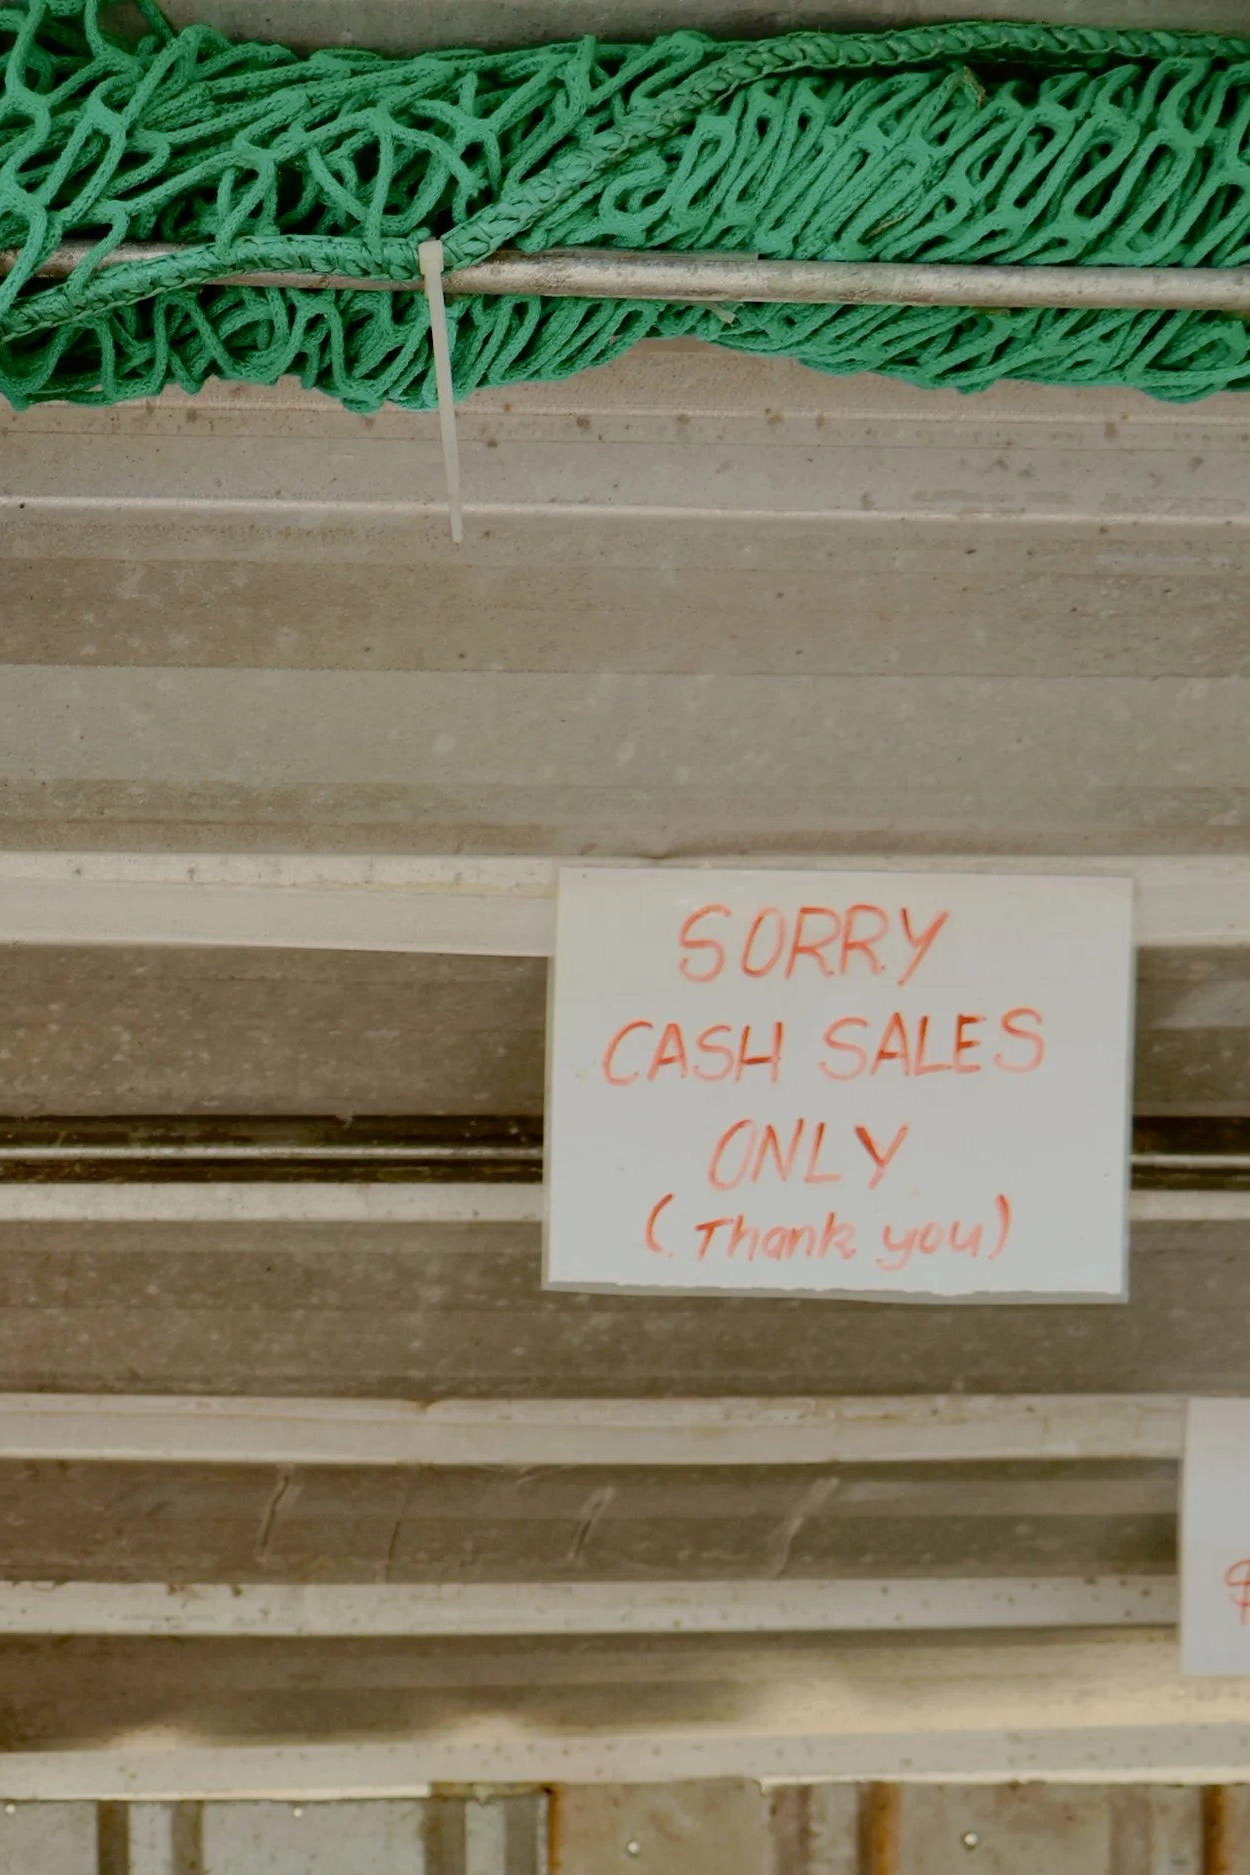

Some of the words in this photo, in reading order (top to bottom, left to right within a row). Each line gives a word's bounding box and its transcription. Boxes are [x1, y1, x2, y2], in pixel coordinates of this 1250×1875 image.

[677, 902, 951, 988] SORRY
[602, 1018, 786, 1086] CASH
[817, 1006, 1047, 1081] SALES
[706, 1116, 910, 1190] ONLY
[643, 1192, 858, 1262] (Thank
[876, 1193, 1013, 1273] you)
